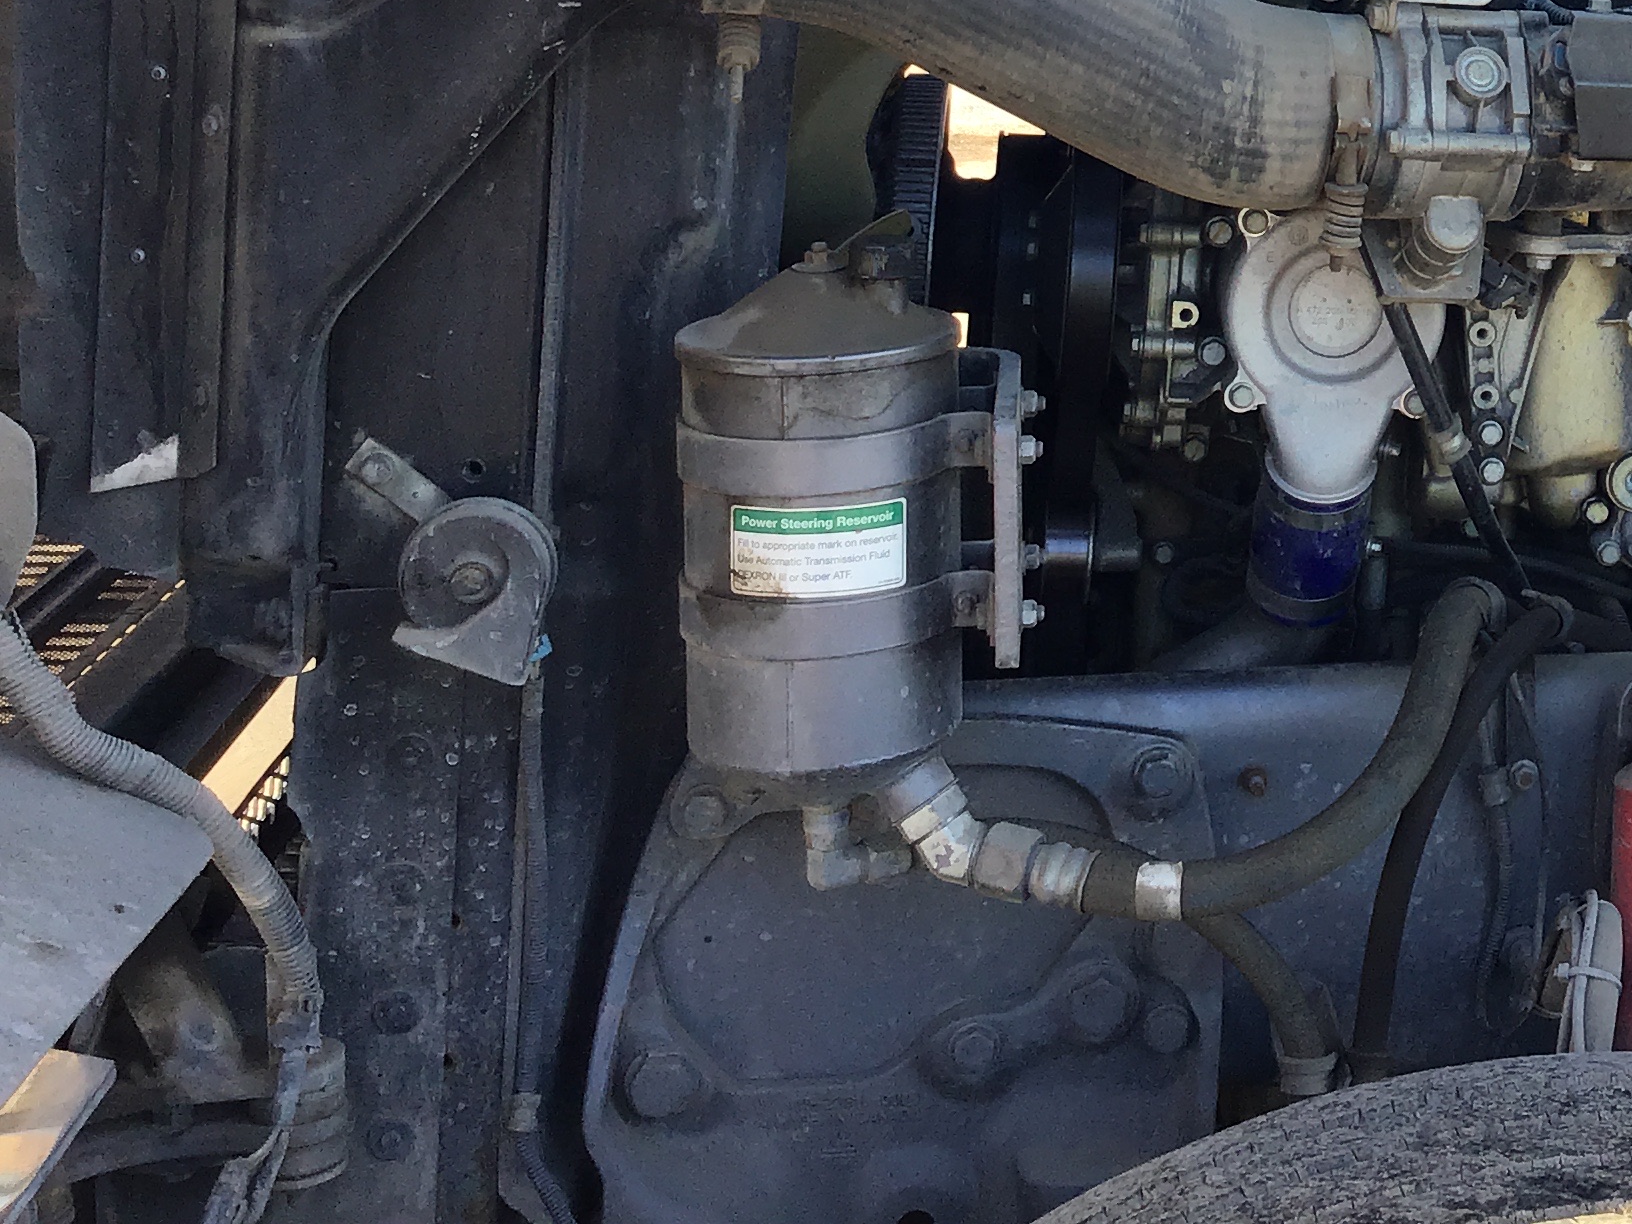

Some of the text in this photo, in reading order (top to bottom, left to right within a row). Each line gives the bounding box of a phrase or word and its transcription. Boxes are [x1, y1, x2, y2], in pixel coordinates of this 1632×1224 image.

[741, 509, 894, 531] Power Steering Reservoir
[738, 538, 750, 548] Fill
[751, 539, 761, 549] to
[762, 540, 816, 553] appropriate
[817, 538, 843, 549] mark
[845, 539, 857, 548] on
[738, 549, 891, 566] Use Automatic Transmission Fluid
[789, 573, 799, 582] or
[801, 572, 831, 584] Super
